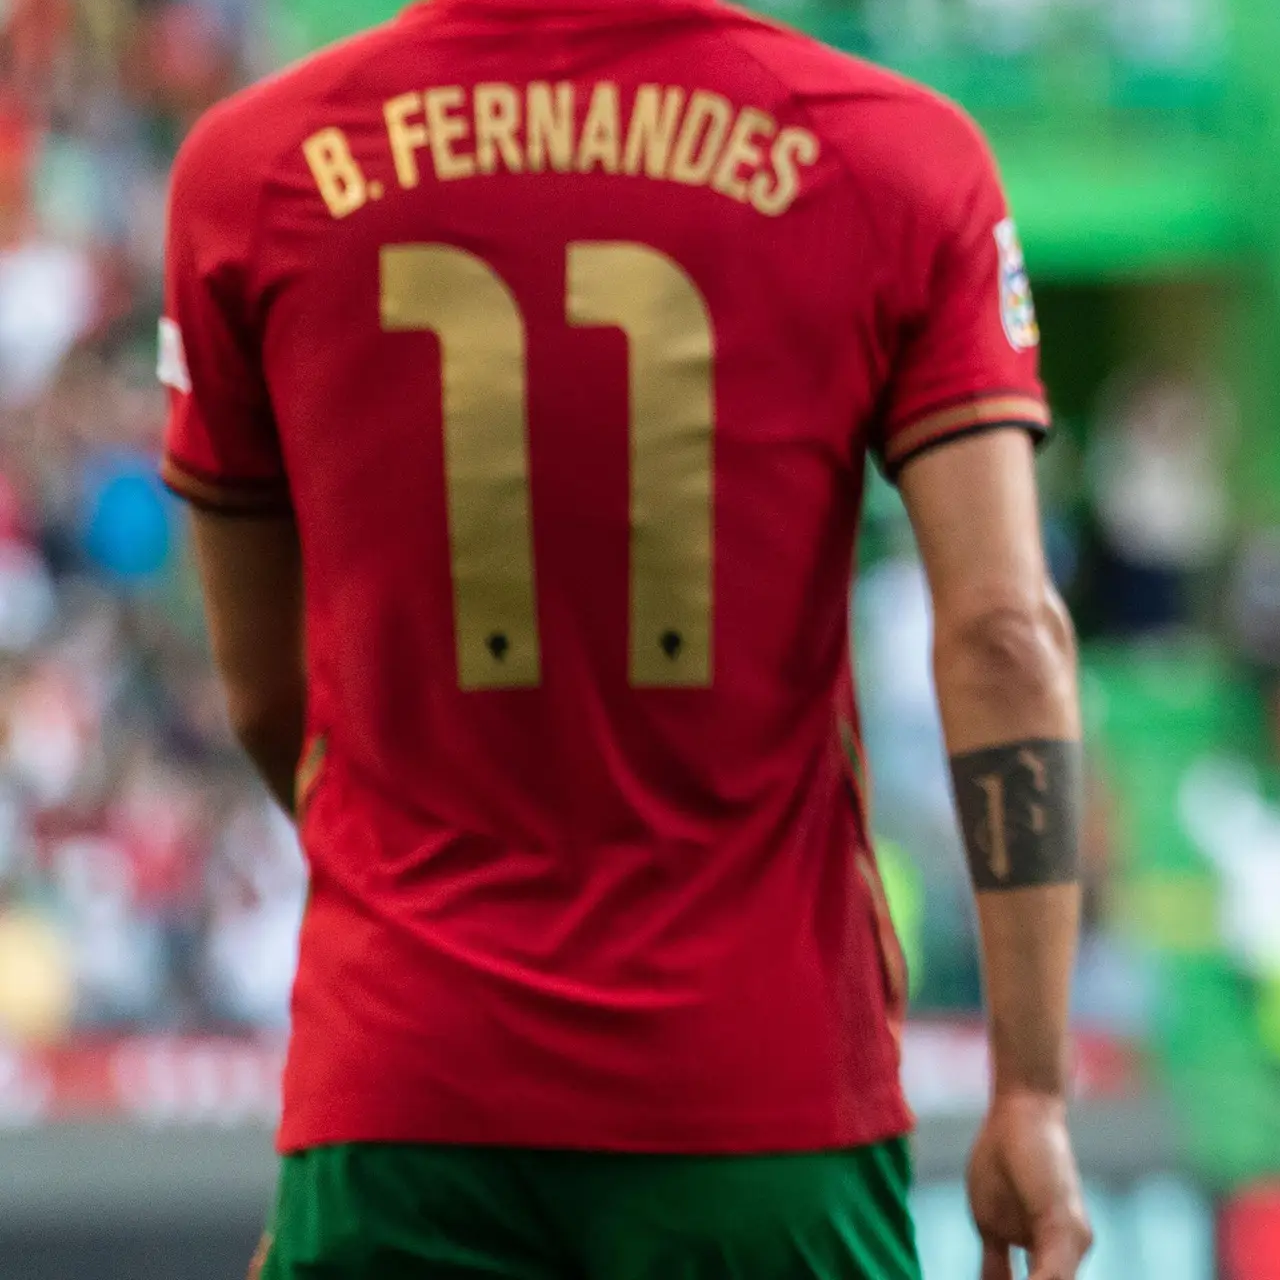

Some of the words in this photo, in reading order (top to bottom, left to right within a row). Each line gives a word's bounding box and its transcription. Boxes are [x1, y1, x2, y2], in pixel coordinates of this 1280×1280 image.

[302, 126, 383, 218] B.
[383, 81, 819, 217] FERNANDES
[380, 241, 715, 690] 11
